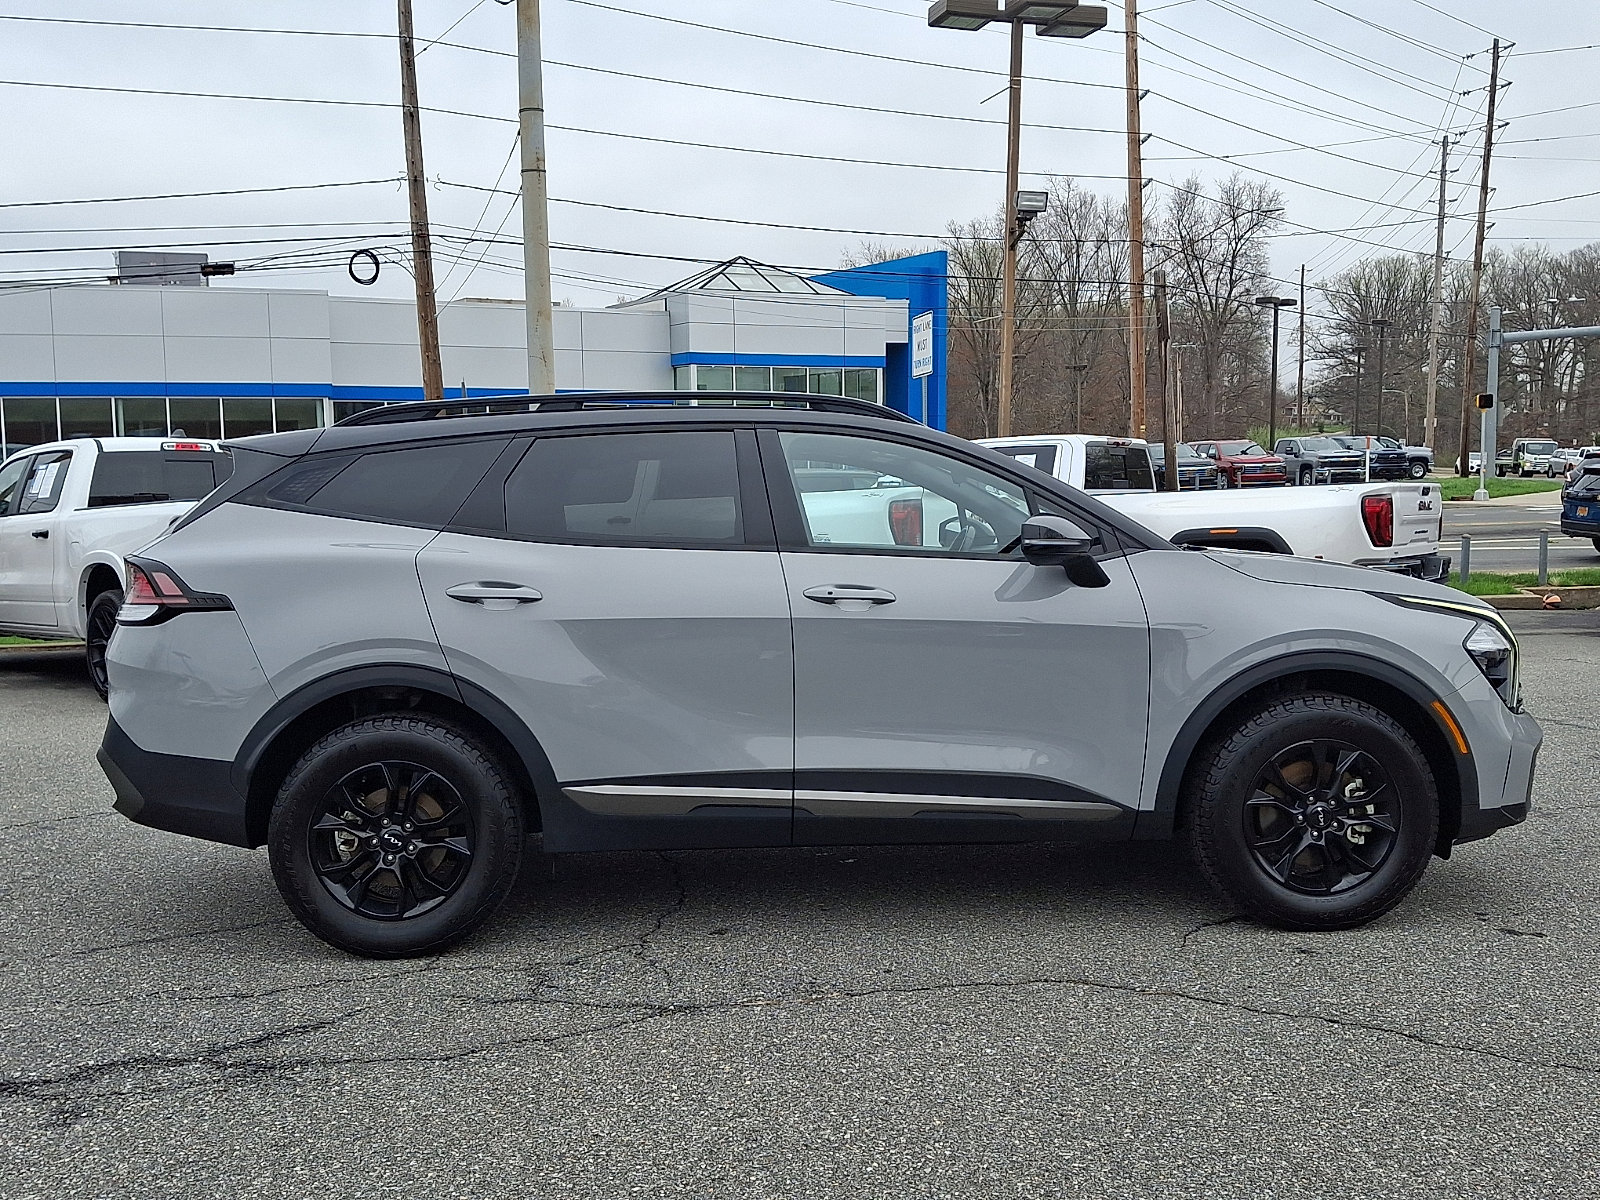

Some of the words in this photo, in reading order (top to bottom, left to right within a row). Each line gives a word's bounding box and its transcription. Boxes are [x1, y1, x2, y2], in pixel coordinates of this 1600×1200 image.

[922, 319, 932, 332] LANE
[917, 338, 928, 352] MUST
[922, 355, 932, 367] RIGHT
[1418, 500, 1433, 511] GMC
